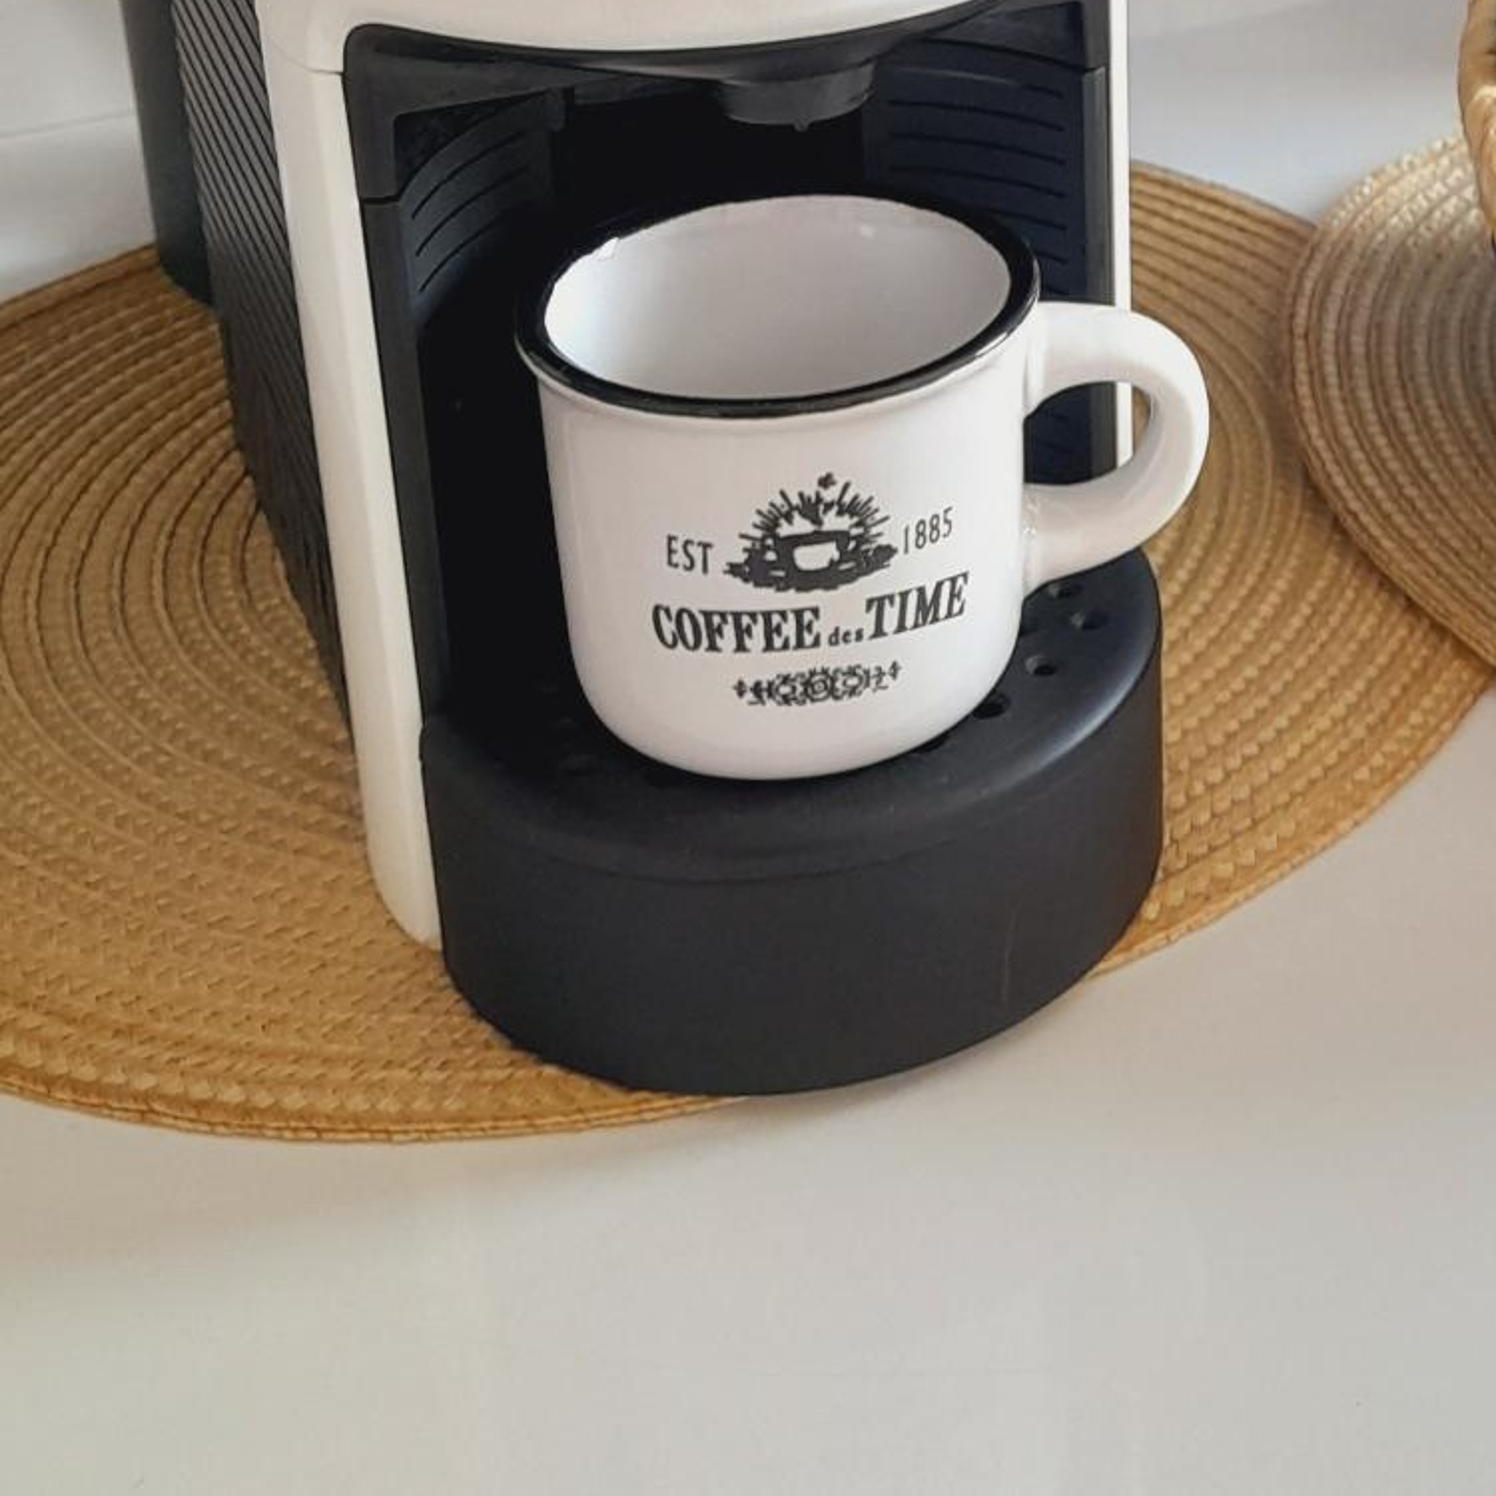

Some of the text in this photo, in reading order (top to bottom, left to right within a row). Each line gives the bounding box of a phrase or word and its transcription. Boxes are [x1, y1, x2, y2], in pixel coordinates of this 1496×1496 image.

[666, 506, 954, 575] EST 1885
[652, 603, 822, 654] COFFEE
[864, 570, 970, 641] TIME
